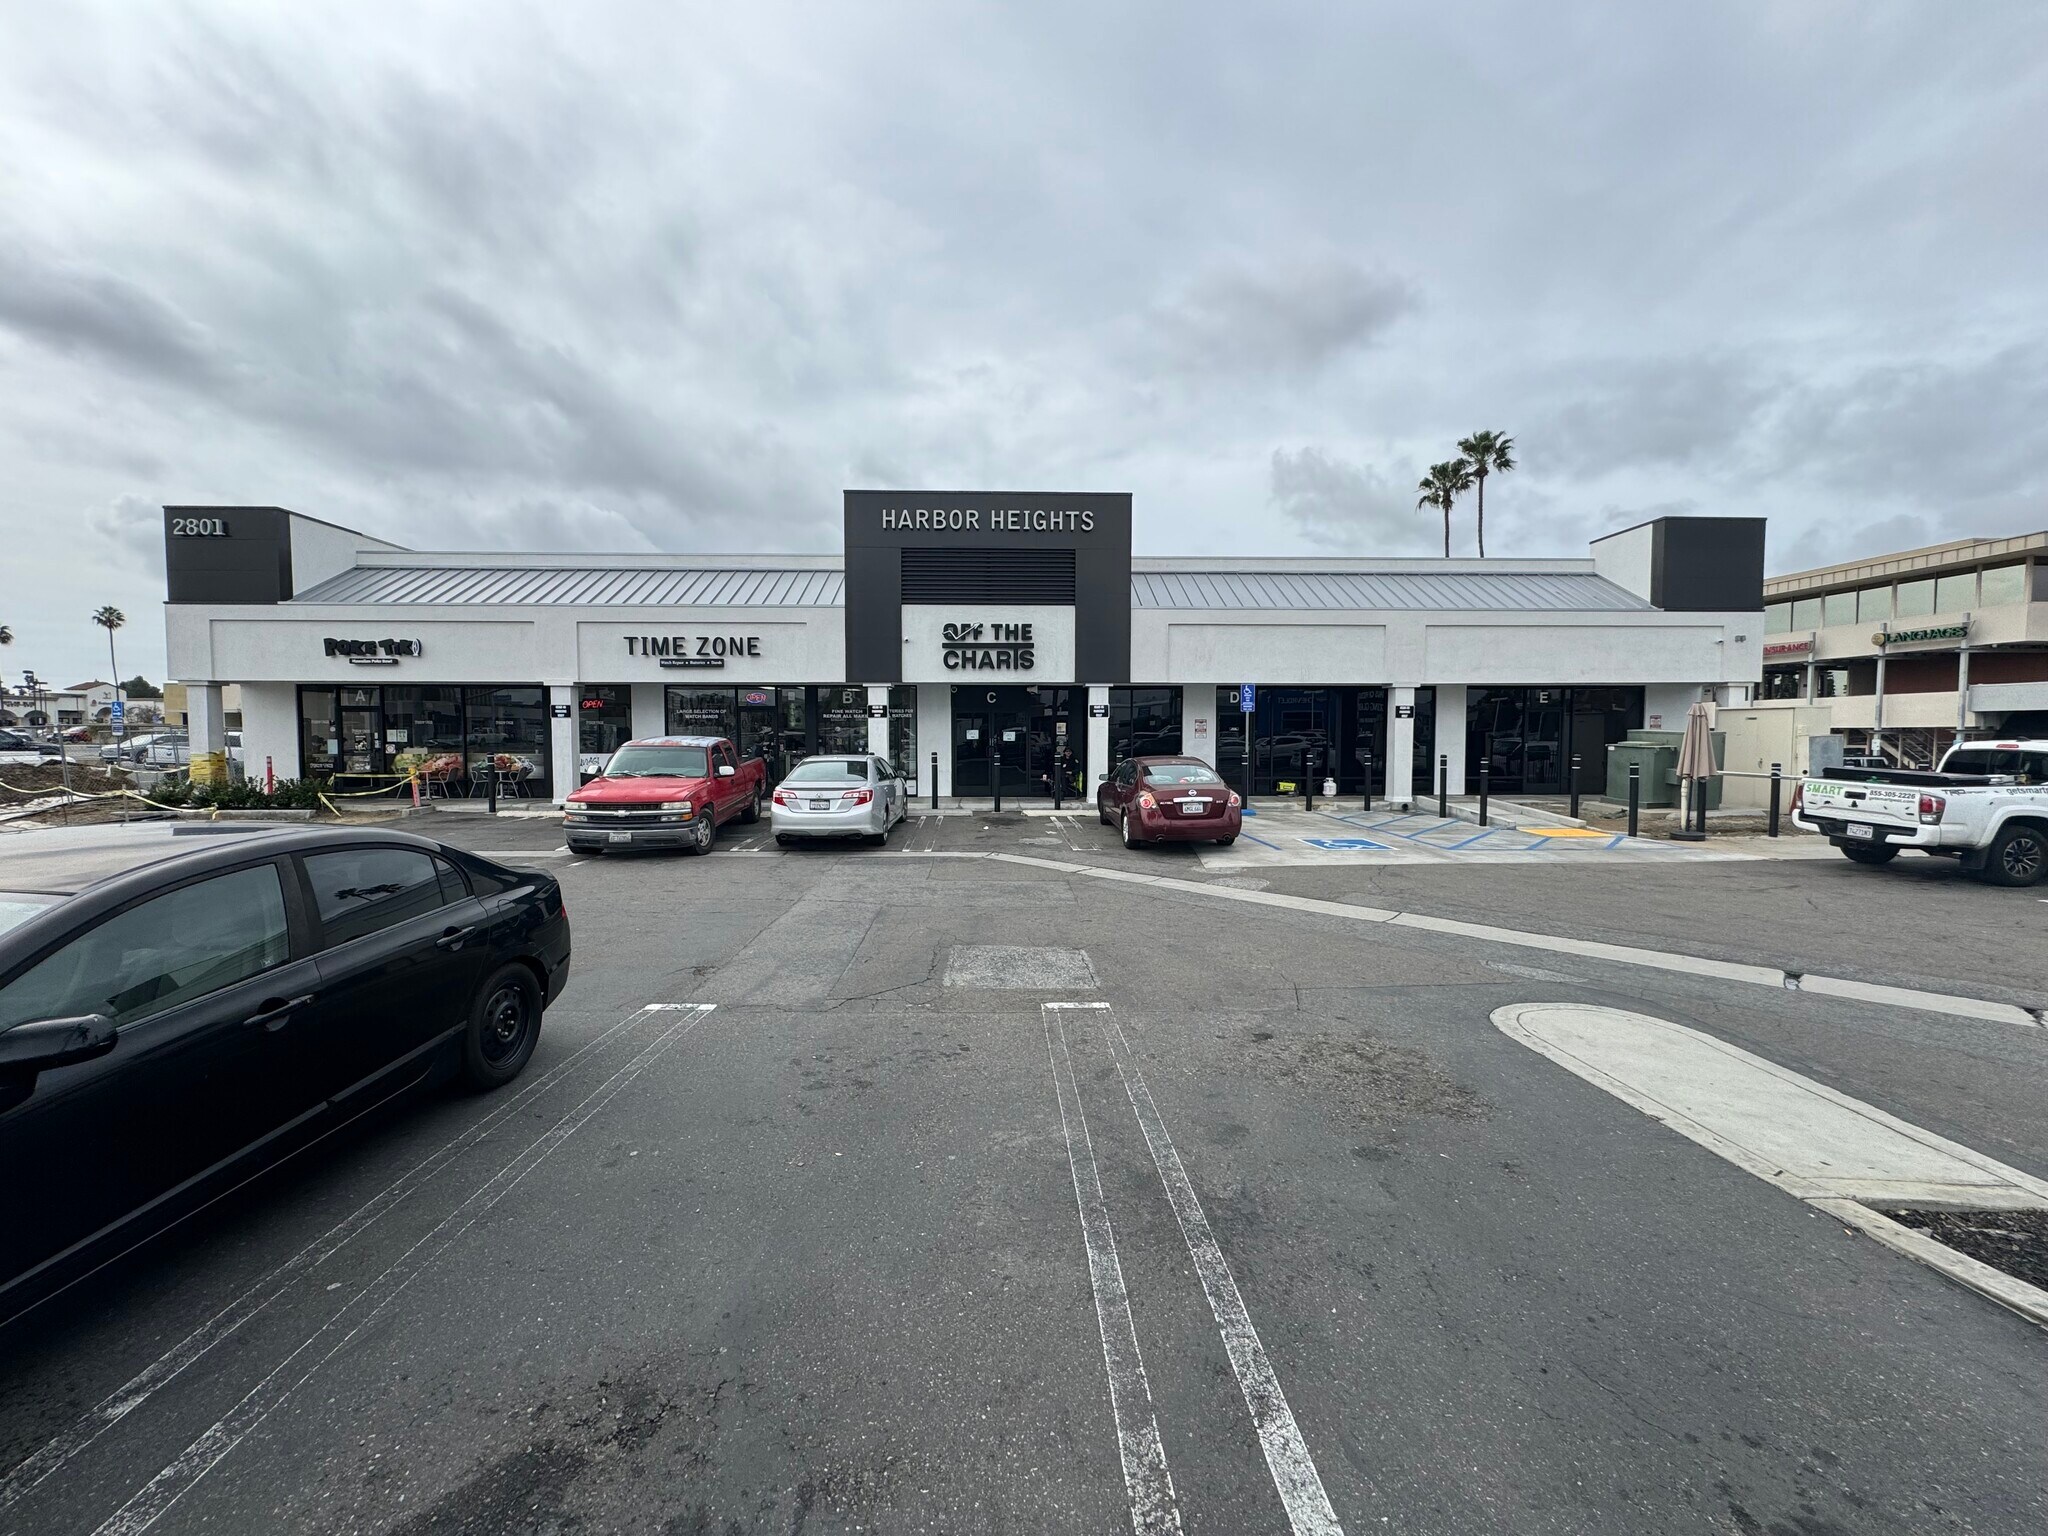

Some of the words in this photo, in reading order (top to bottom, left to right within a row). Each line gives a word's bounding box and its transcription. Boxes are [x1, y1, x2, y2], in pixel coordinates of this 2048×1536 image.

[882, 509, 980, 530] HARBOR
[991, 510, 1095, 531] HEIGHTS
[172, 518, 226, 536] 2801
[942, 622, 984, 641] OFF
[991, 623, 1033, 641] THE
[1886, 626, 1969, 643] LANGUAGES
[323, 637, 378, 657] POKE
[623, 636, 687, 656] TIME
[696, 636, 761, 656] ZONE
[943, 648, 1035, 670] CHARTS
[355, 689, 366, 702] A
[843, 691, 853, 704] B
[987, 691, 997, 704] C
[1229, 691, 1240, 703] D
[1540, 691, 1549, 703] E
[582, 700, 604, 709] OPEN
[1805, 783, 1843, 796] SMART
[1869, 789, 1916, 800] 855-305-2226
